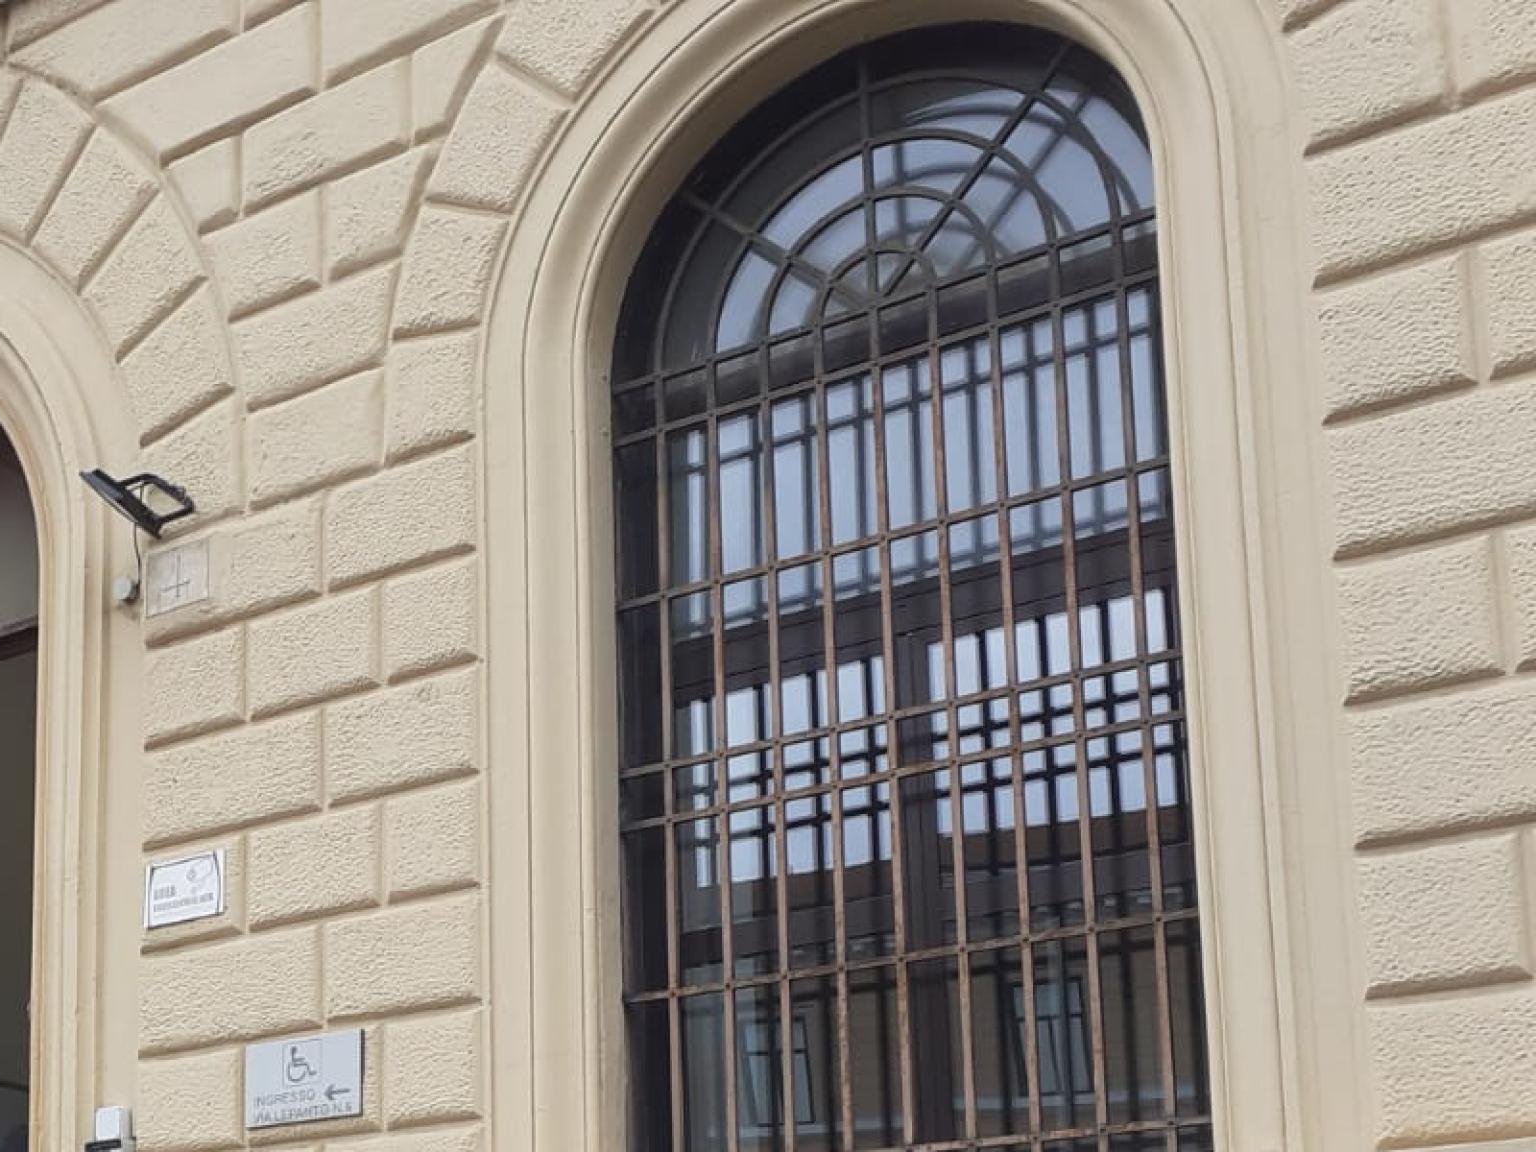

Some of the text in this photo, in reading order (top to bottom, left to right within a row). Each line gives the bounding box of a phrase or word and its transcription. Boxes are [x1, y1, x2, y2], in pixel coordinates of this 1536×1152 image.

[253, 1088, 316, 1107] INGRESSO
[253, 1107, 271, 1122] VIA
[272, 1103, 329, 1122] LEPANTO
